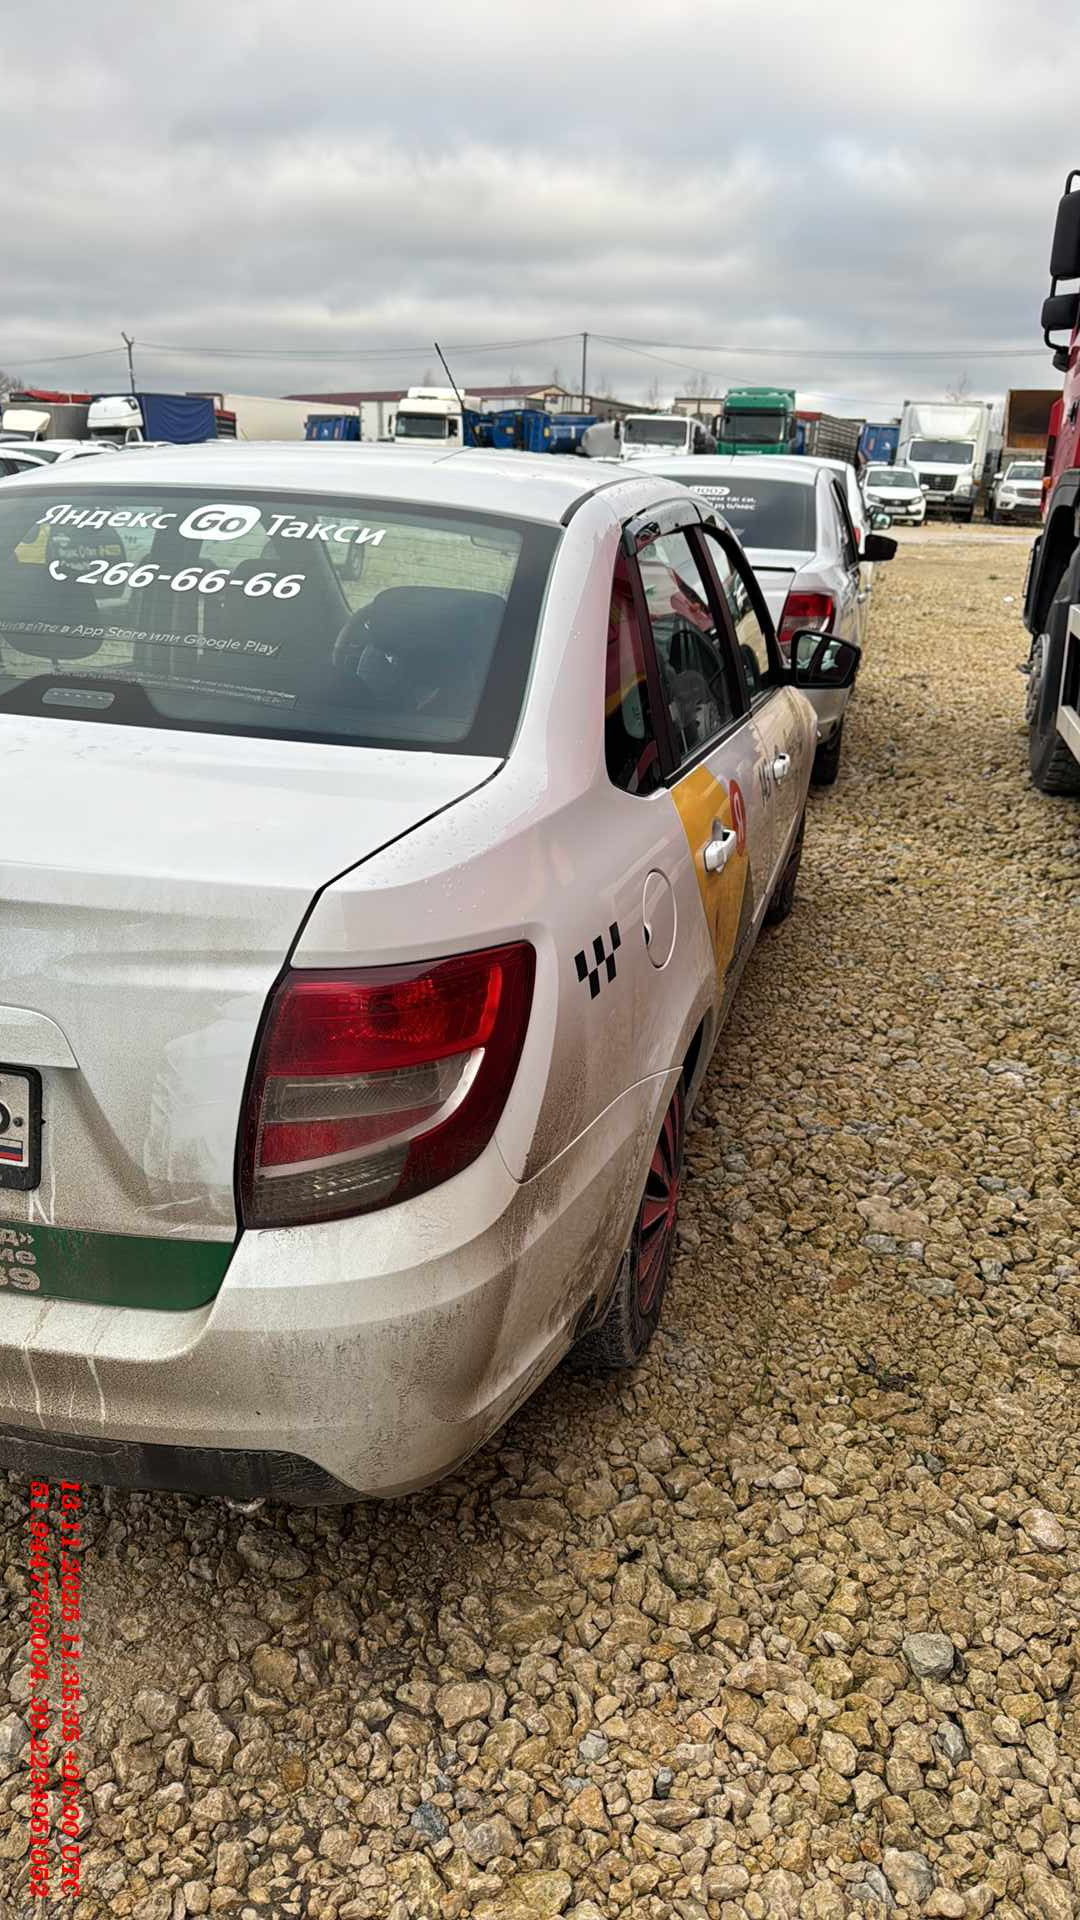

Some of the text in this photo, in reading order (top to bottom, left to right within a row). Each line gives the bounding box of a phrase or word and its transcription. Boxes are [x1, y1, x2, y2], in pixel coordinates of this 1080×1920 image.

[35, 504, 387, 546] Яндекс Go Такси
[75, 559, 306, 599] 266-66-66
[71, 624, 104, 638] App
[107, 626, 148, 640] Store
[149, 631, 181, 643] или
[183, 633, 241, 650] Google
[243, 640, 281, 656] Play
